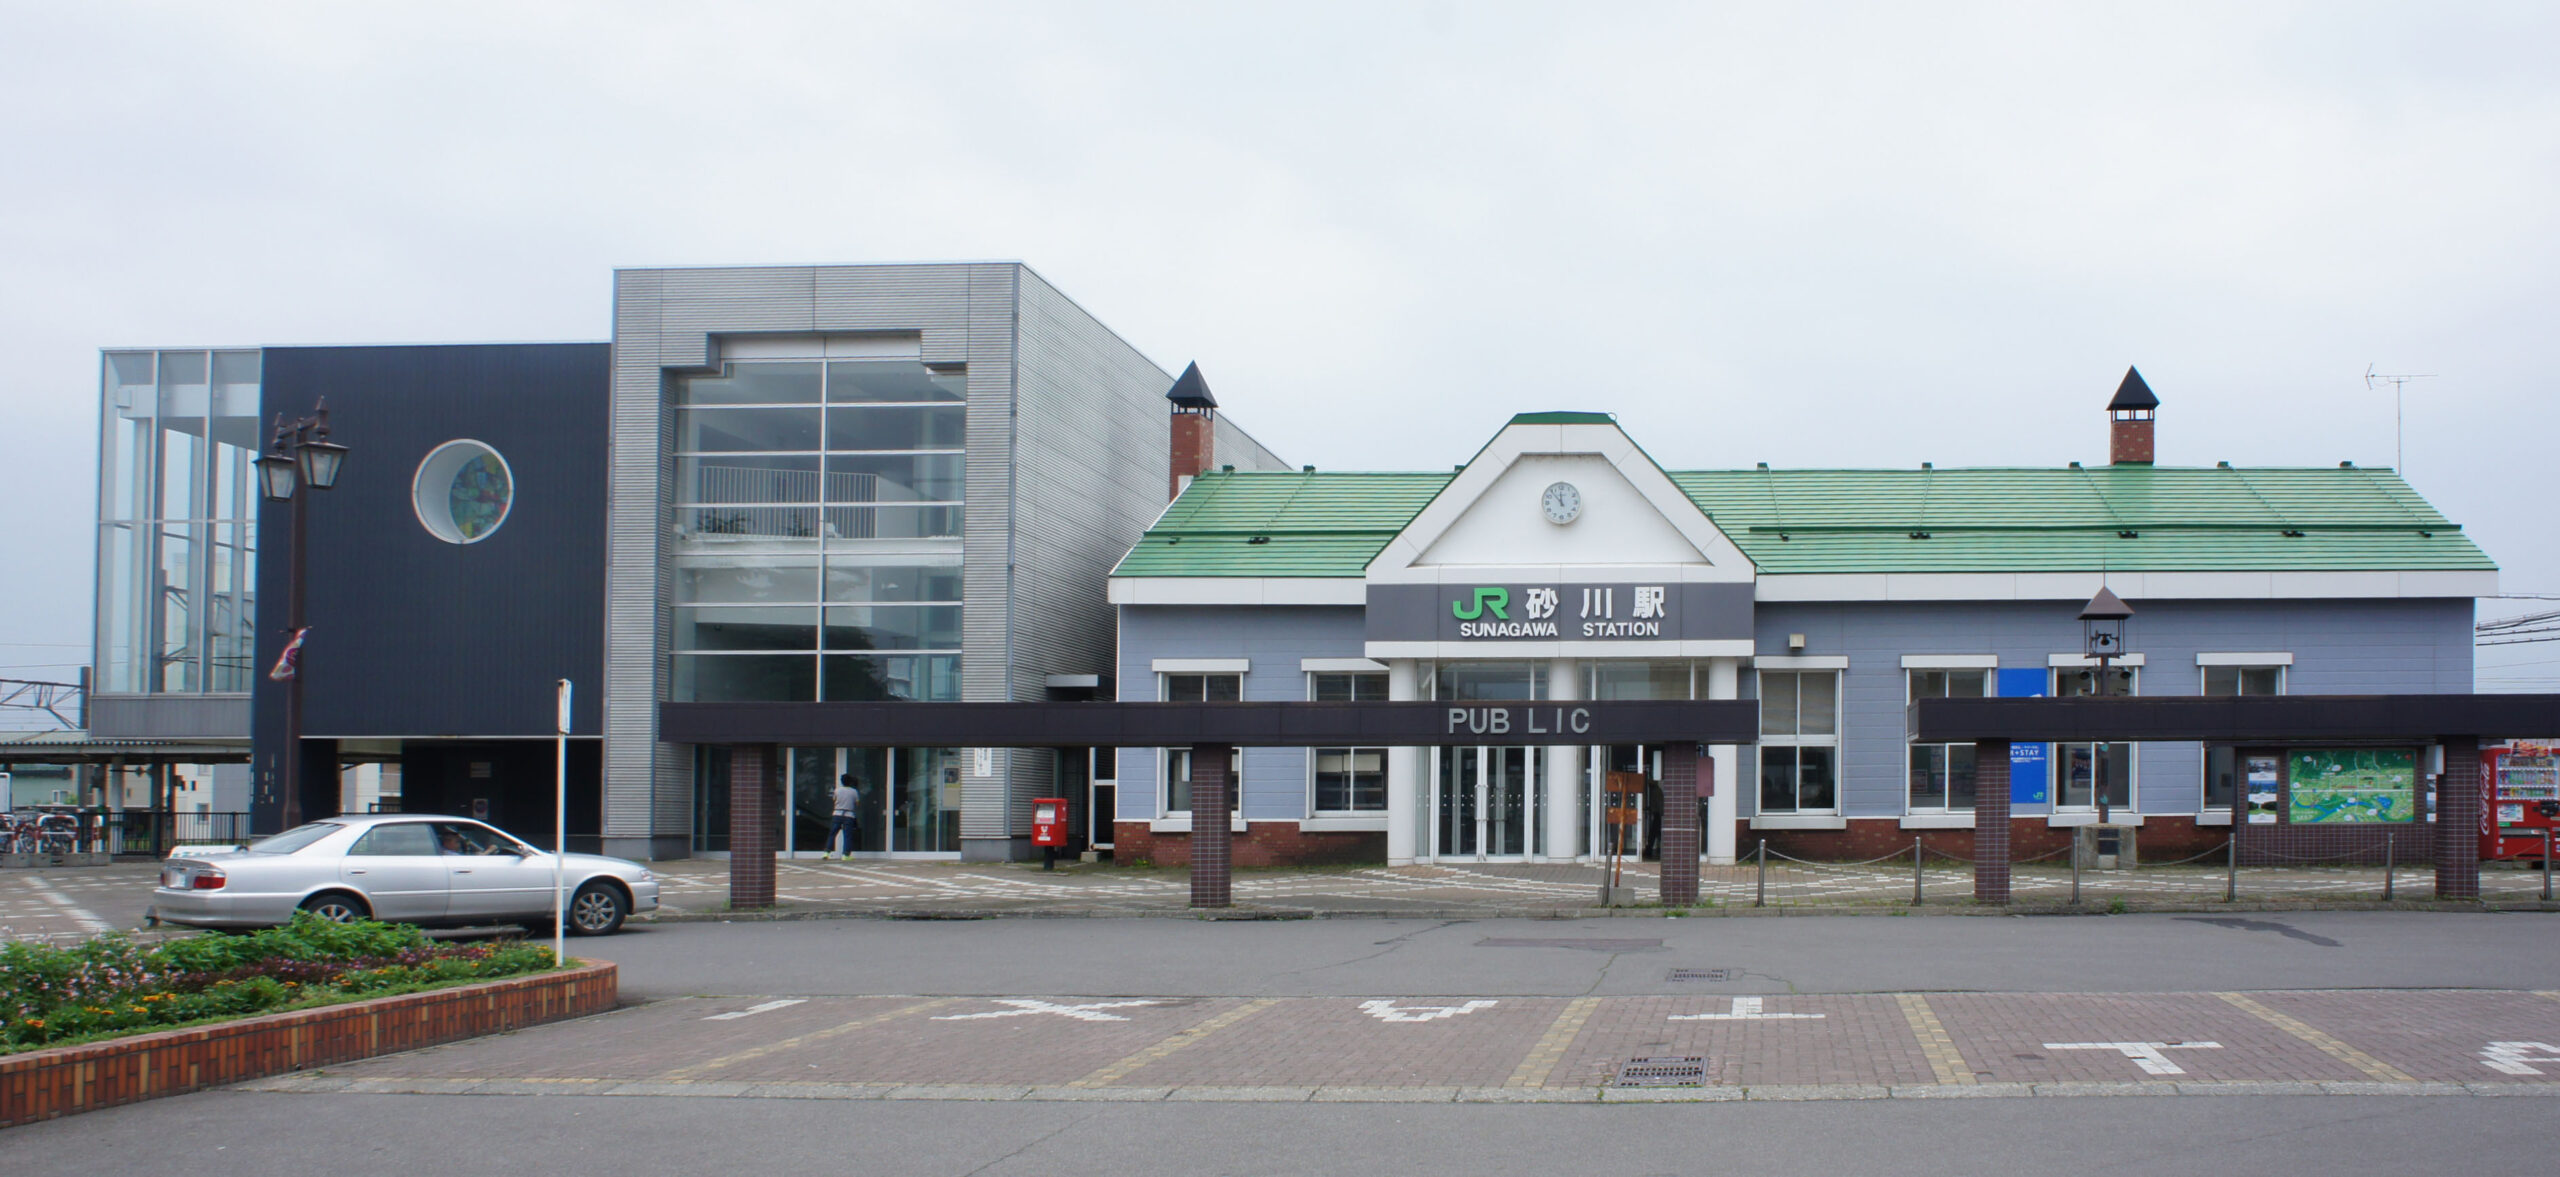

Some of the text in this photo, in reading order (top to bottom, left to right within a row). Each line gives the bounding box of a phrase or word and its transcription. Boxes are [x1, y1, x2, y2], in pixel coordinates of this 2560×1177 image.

[1452, 586, 1665, 619] JR 砂川駅
[1460, 621, 1659, 637] SUNAGAWA STATION
